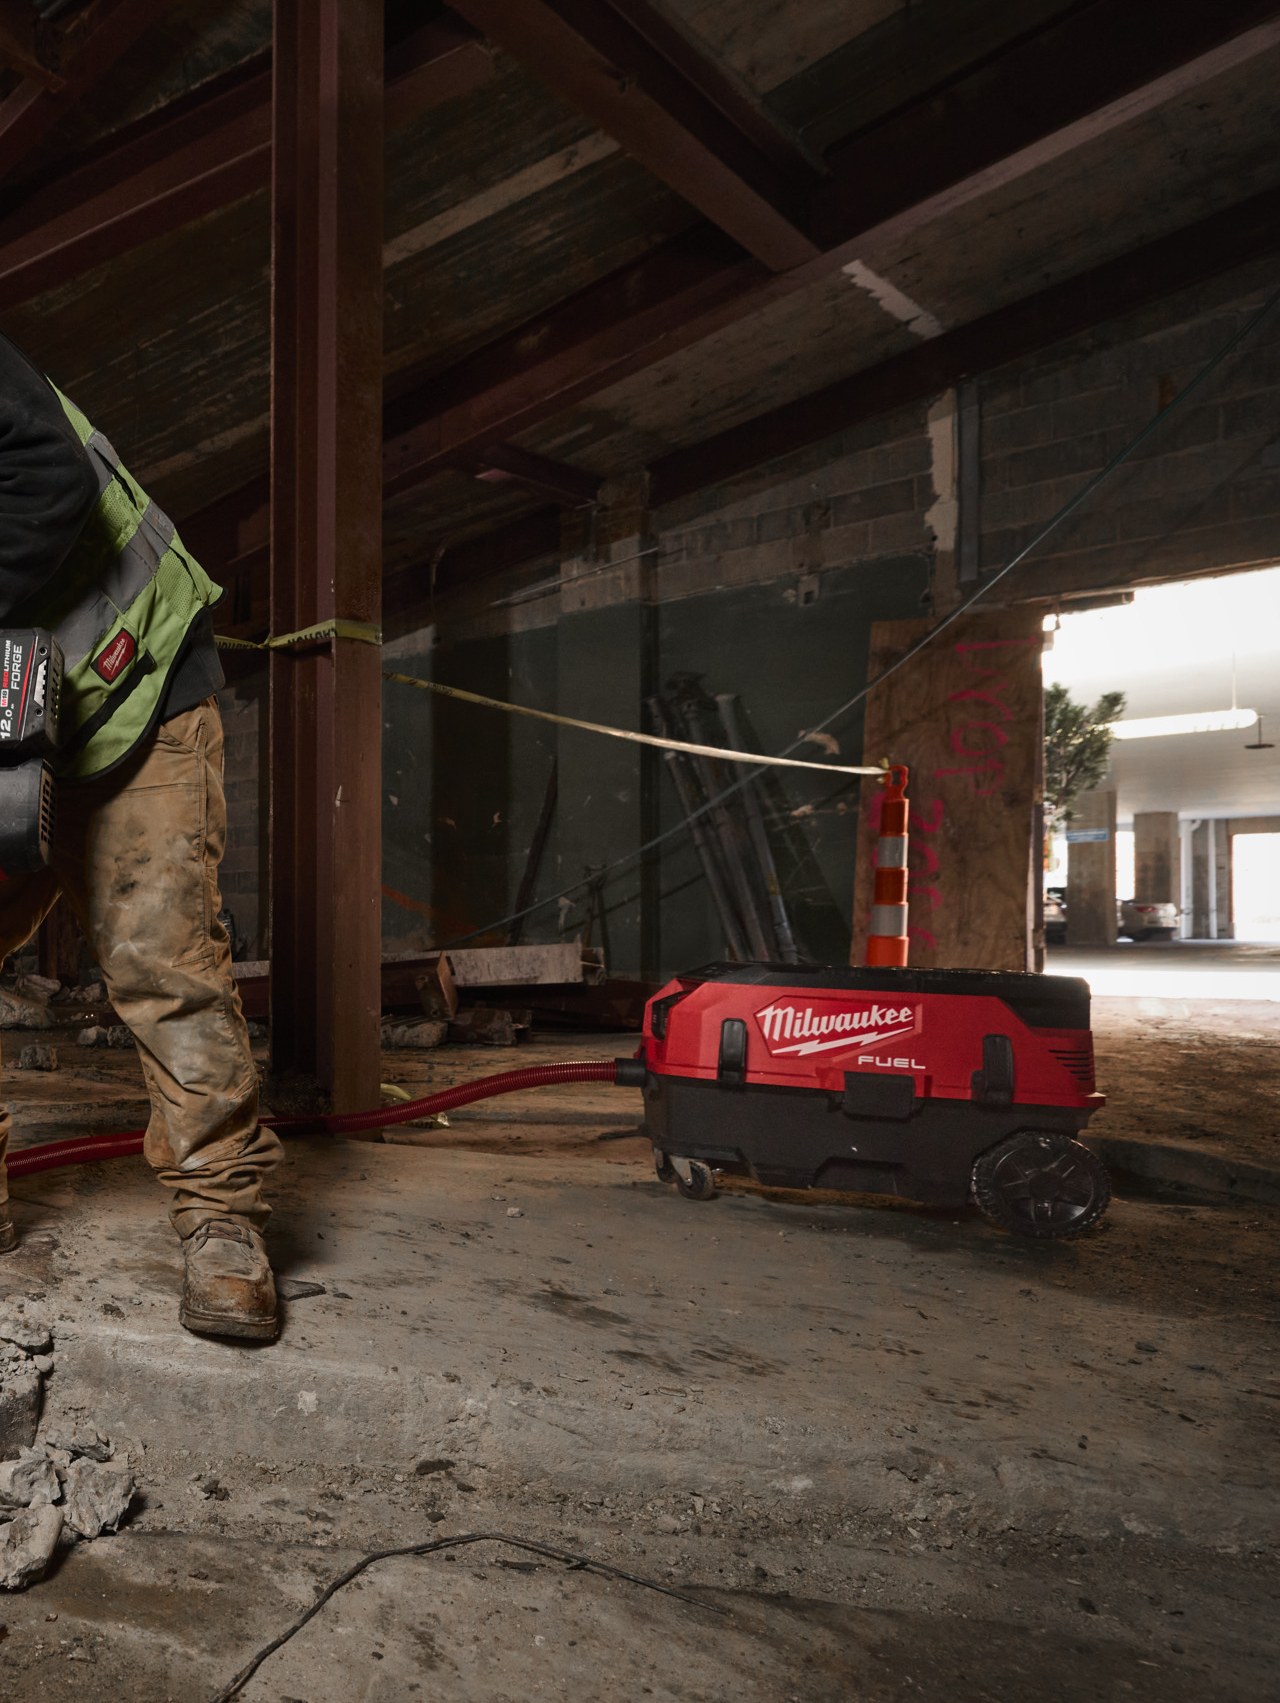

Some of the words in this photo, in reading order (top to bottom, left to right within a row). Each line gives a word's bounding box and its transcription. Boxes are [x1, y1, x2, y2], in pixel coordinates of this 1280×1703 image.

[10, 644, 23, 690] FORGE
[102, 638, 126, 671] Milwaukee
[0, 709, 13, 739] 12.0
[755, 1004, 914, 1042] Milwaukee
[857, 1055, 926, 1070] FUEL
